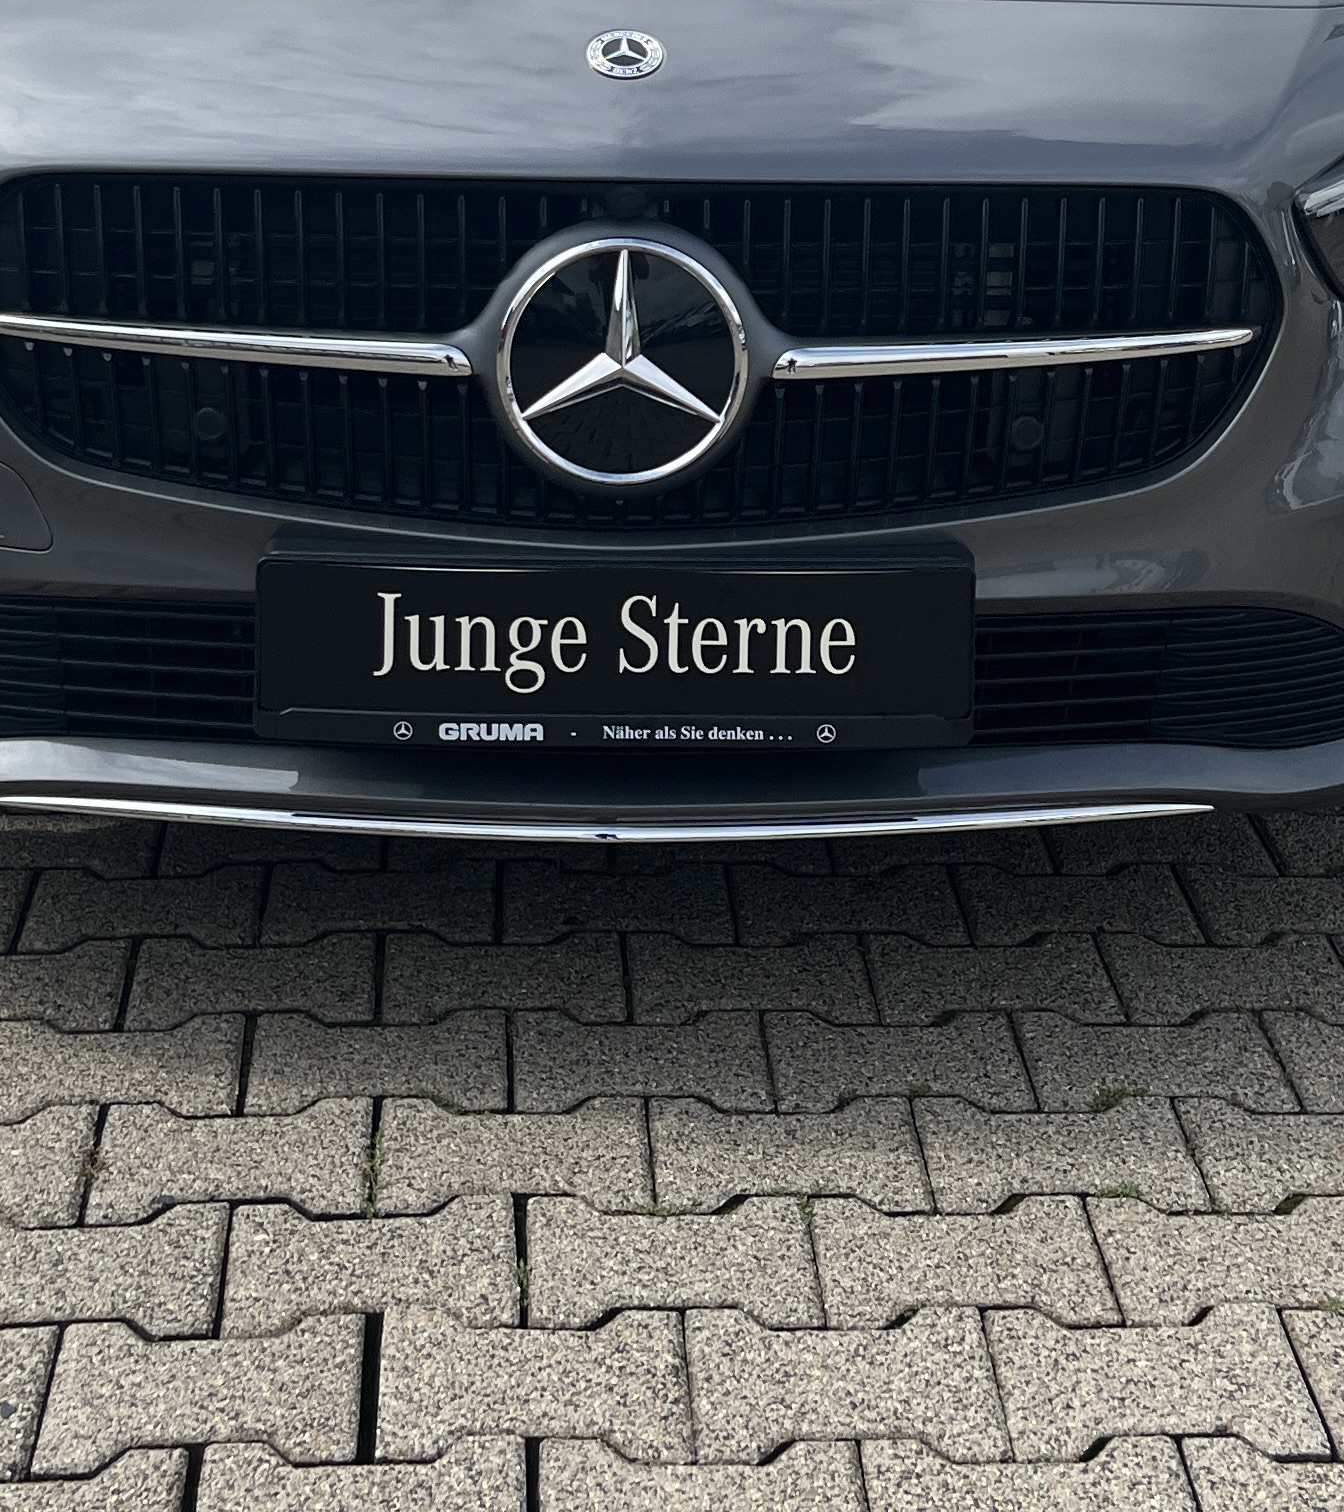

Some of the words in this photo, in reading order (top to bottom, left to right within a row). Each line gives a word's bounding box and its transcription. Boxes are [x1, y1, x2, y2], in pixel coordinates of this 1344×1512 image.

[372, 591, 587, 694] Junge
[618, 594, 856, 675] Sterne
[438, 722, 544, 741] GRUMA
[602, 724, 652, 740] Näher
[655, 725, 677, 740] als
[680, 726, 704, 740] Sie
[707, 726, 764, 741] denken
